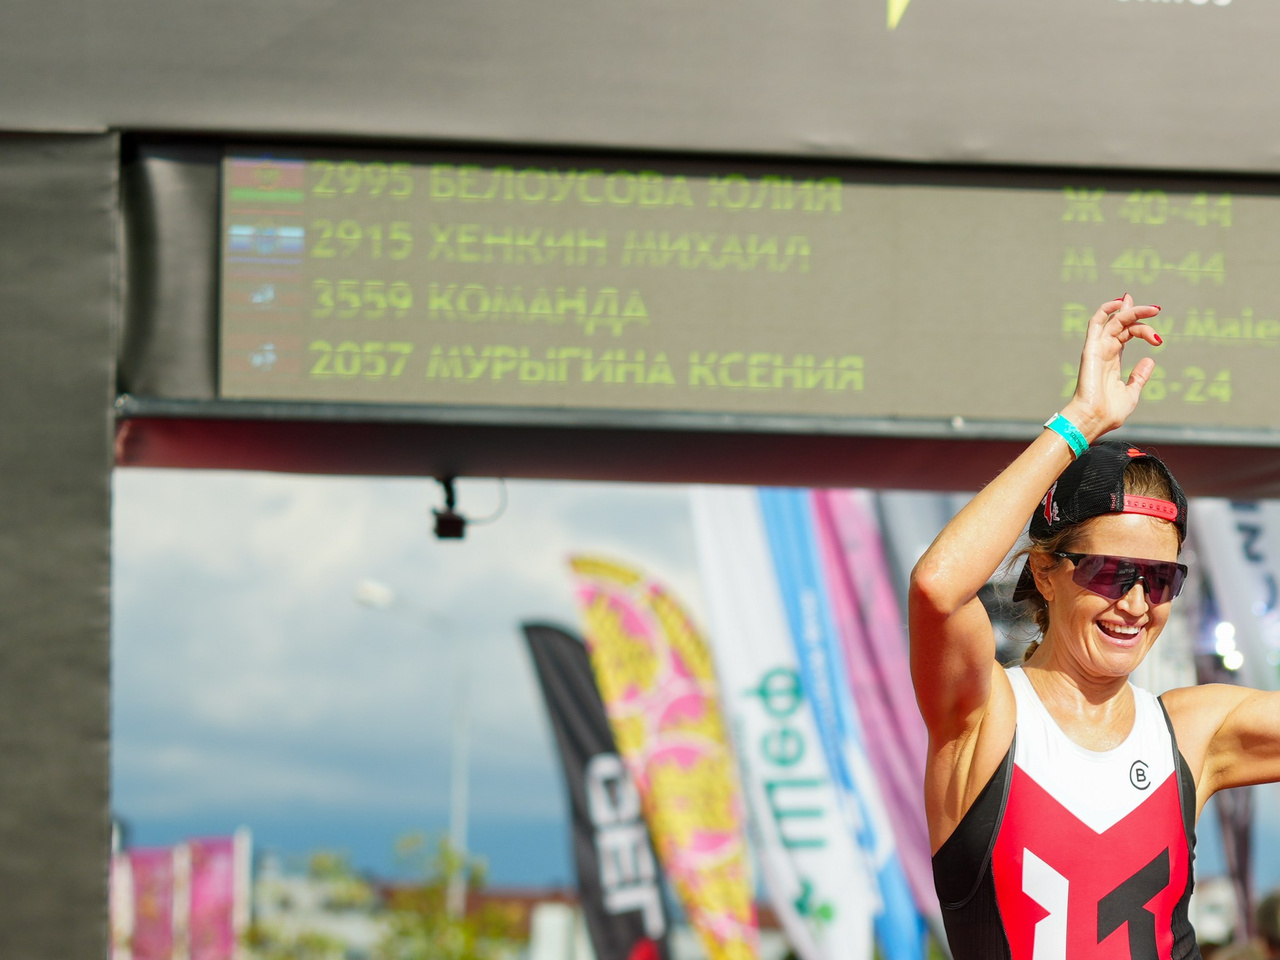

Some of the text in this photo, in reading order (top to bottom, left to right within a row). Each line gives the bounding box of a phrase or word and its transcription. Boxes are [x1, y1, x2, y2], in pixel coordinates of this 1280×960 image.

[312, 160, 414, 198] 2995
[429, 163, 695, 208] БЕЛОУСОВА
[707, 173, 844, 213] ЮЛИЯ
[310, 219, 414, 262] 2915
[427, 221, 608, 268] ХЕНКИН
[1110, 246, 1227, 287] 40-44
[311, 278, 414, 320] 3559
[428, 282, 650, 338] КОМАНДА
[309, 339, 415, 381] 2057
[426, 344, 678, 387] МУРЫГИНА
[688, 352, 865, 391] КСЕНИЯ
